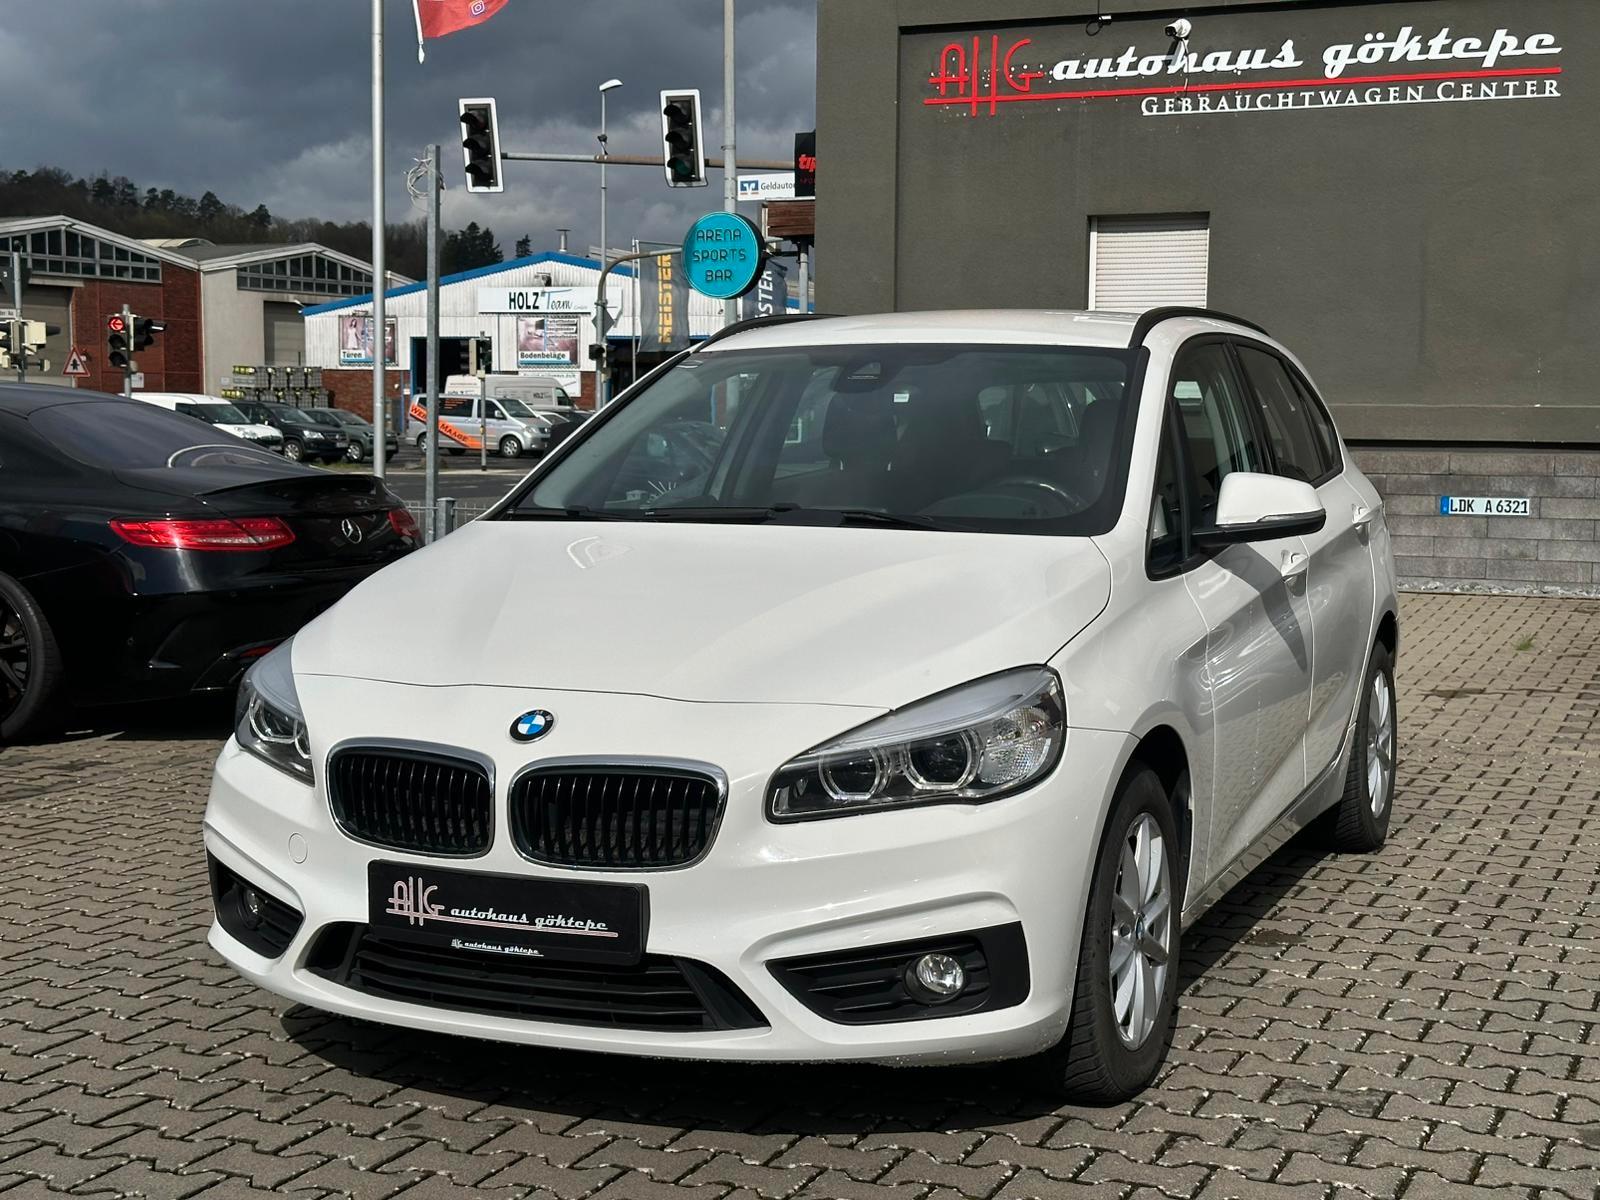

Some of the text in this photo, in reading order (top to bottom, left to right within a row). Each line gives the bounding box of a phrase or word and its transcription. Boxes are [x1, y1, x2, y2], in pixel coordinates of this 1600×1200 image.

[1052, 39, 1303, 80] autohaus
[1322, 26, 1562, 79] göktepe
[696, 228, 742, 241] ARENA
[692, 248, 746, 262] SPORTS
[705, 269, 732, 281] BAR
[508, 291, 540, 310] HOLZ
[542, 289, 573, 310] Team
[657, 254, 672, 343] MEISTER
[1450, 498, 1528, 514] LDK A 6321
[450, 907, 530, 924] autohaus
[534, 914, 609, 931] göktepe
[464, 941, 502, 951] autohaus
[504, 945, 540, 955] göktepe
